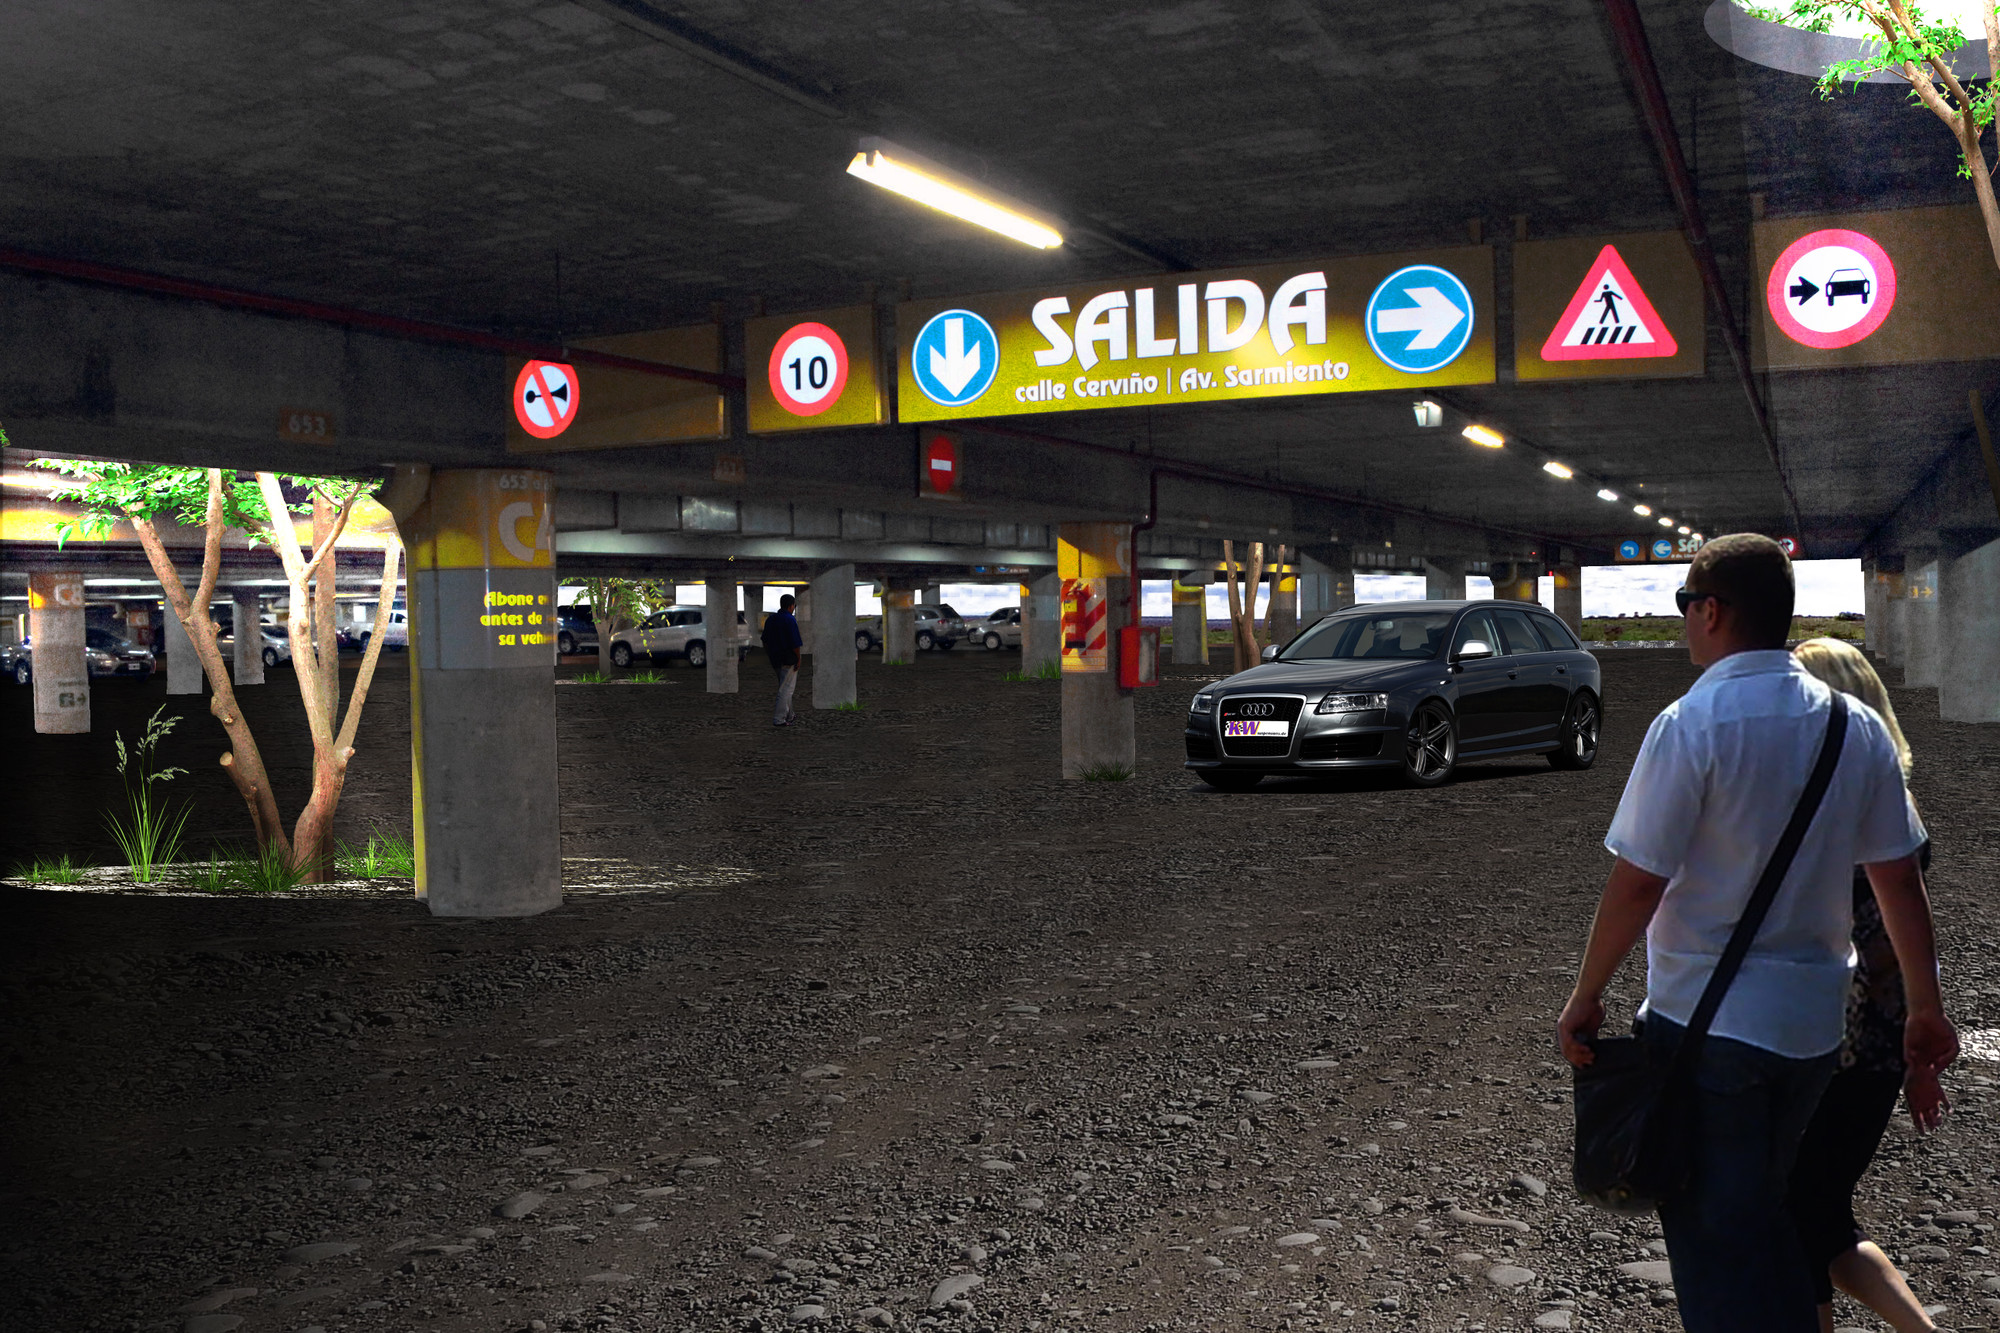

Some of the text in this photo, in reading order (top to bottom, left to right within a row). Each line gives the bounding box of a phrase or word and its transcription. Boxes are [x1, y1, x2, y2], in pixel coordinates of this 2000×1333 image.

[1032, 271, 1328, 371] SALIDA
[788, 355, 828, 390] 10
[1015, 359, 1350, 403] calle Cerviño Av. Sarmiento
[289, 413, 326, 437] 653
[483, 591, 534, 608] Abone
[480, 612, 524, 627] antes
[527, 611, 543, 626] de
[1228, 721, 1260, 735] KW
